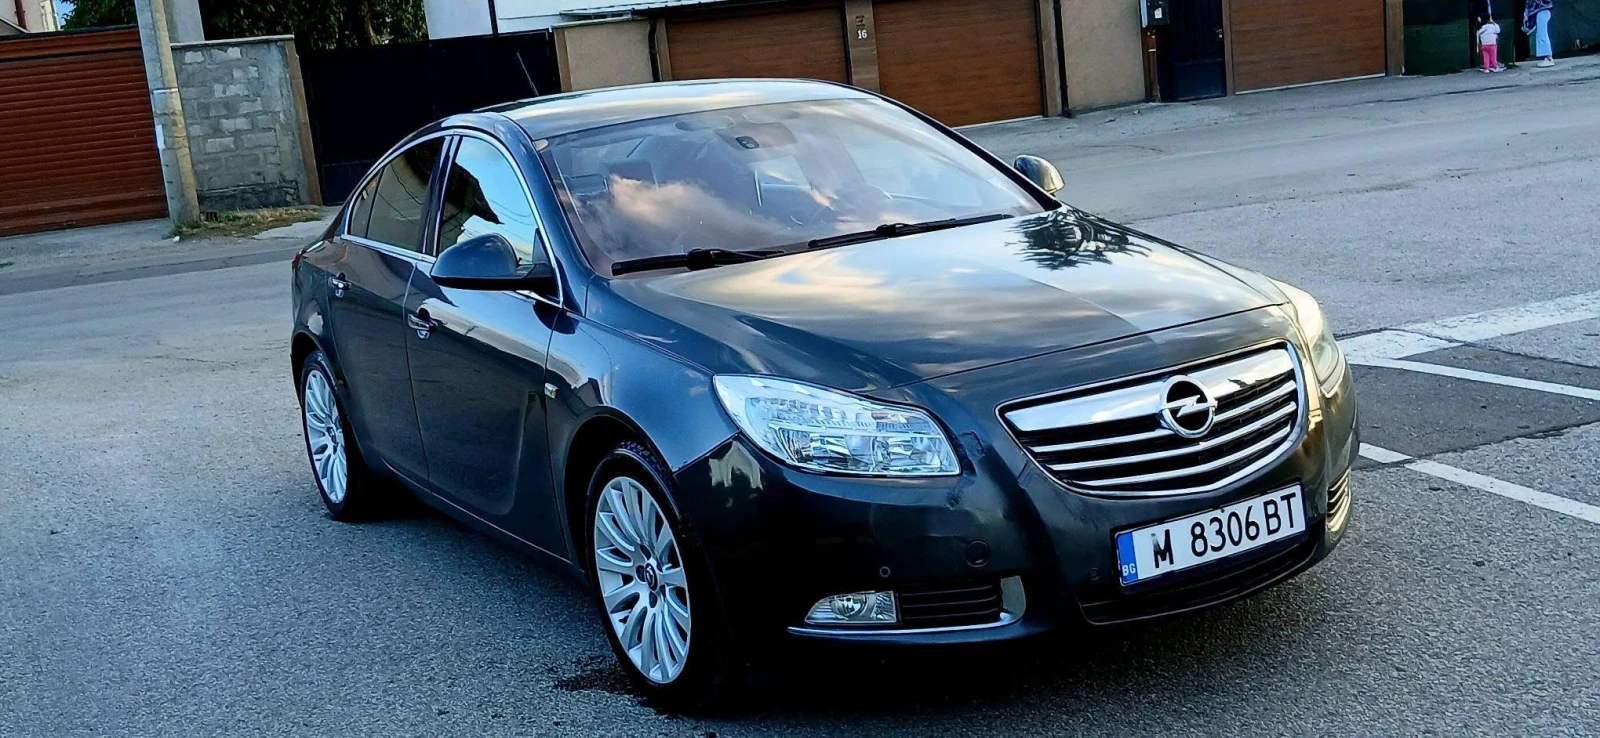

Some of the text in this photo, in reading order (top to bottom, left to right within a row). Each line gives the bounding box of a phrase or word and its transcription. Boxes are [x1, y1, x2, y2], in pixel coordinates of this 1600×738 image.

[857, 29, 868, 39] 16
[1151, 492, 1296, 568] M 8306 BT
[1122, 563, 1137, 576] BG
